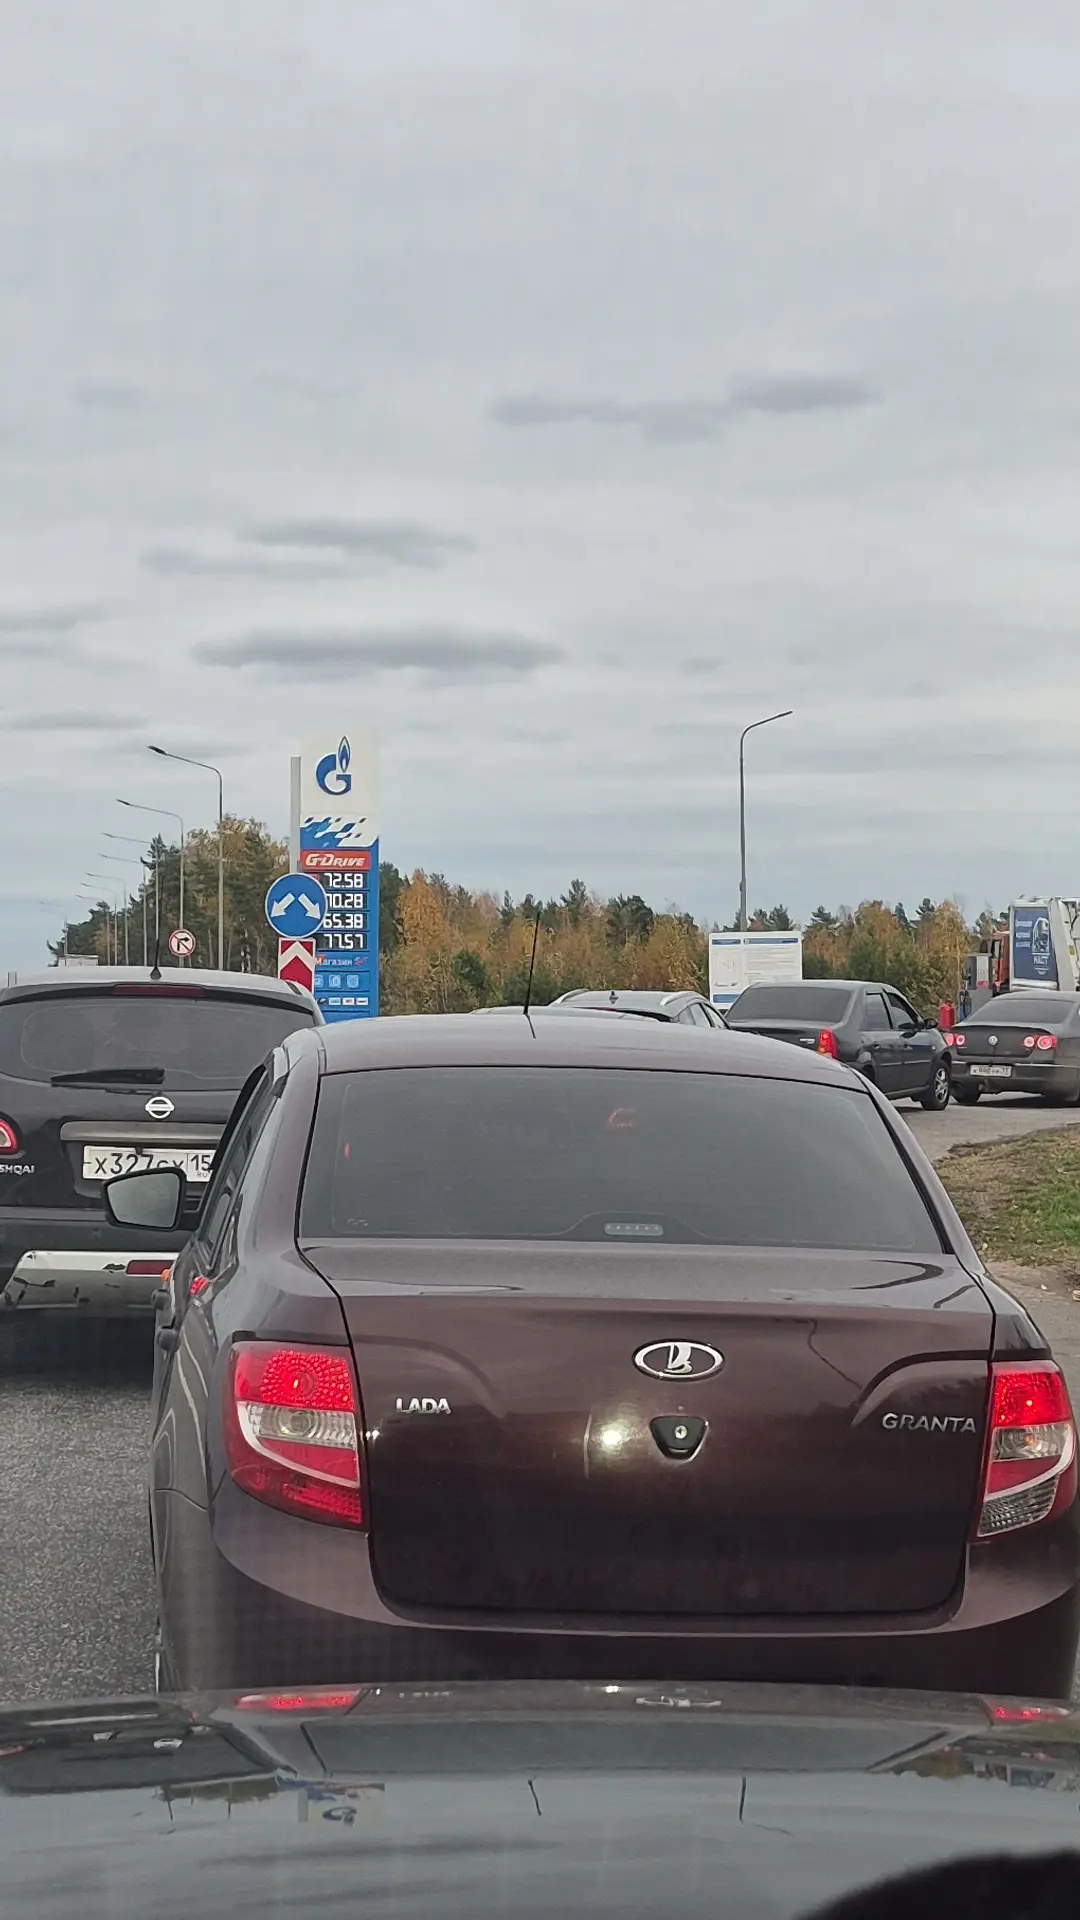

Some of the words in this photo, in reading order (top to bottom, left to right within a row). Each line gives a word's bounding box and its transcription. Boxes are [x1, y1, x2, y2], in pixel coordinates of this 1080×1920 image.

[323, 872, 364, 888] 72.58
[326, 893, 364, 909] 70.28
[323, 913, 364, 929] 65.38
[323, 933, 364, 949] 77.57
[396, 1397, 452, 1414] LADA
[882, 1412, 976, 1433] GRANTA
